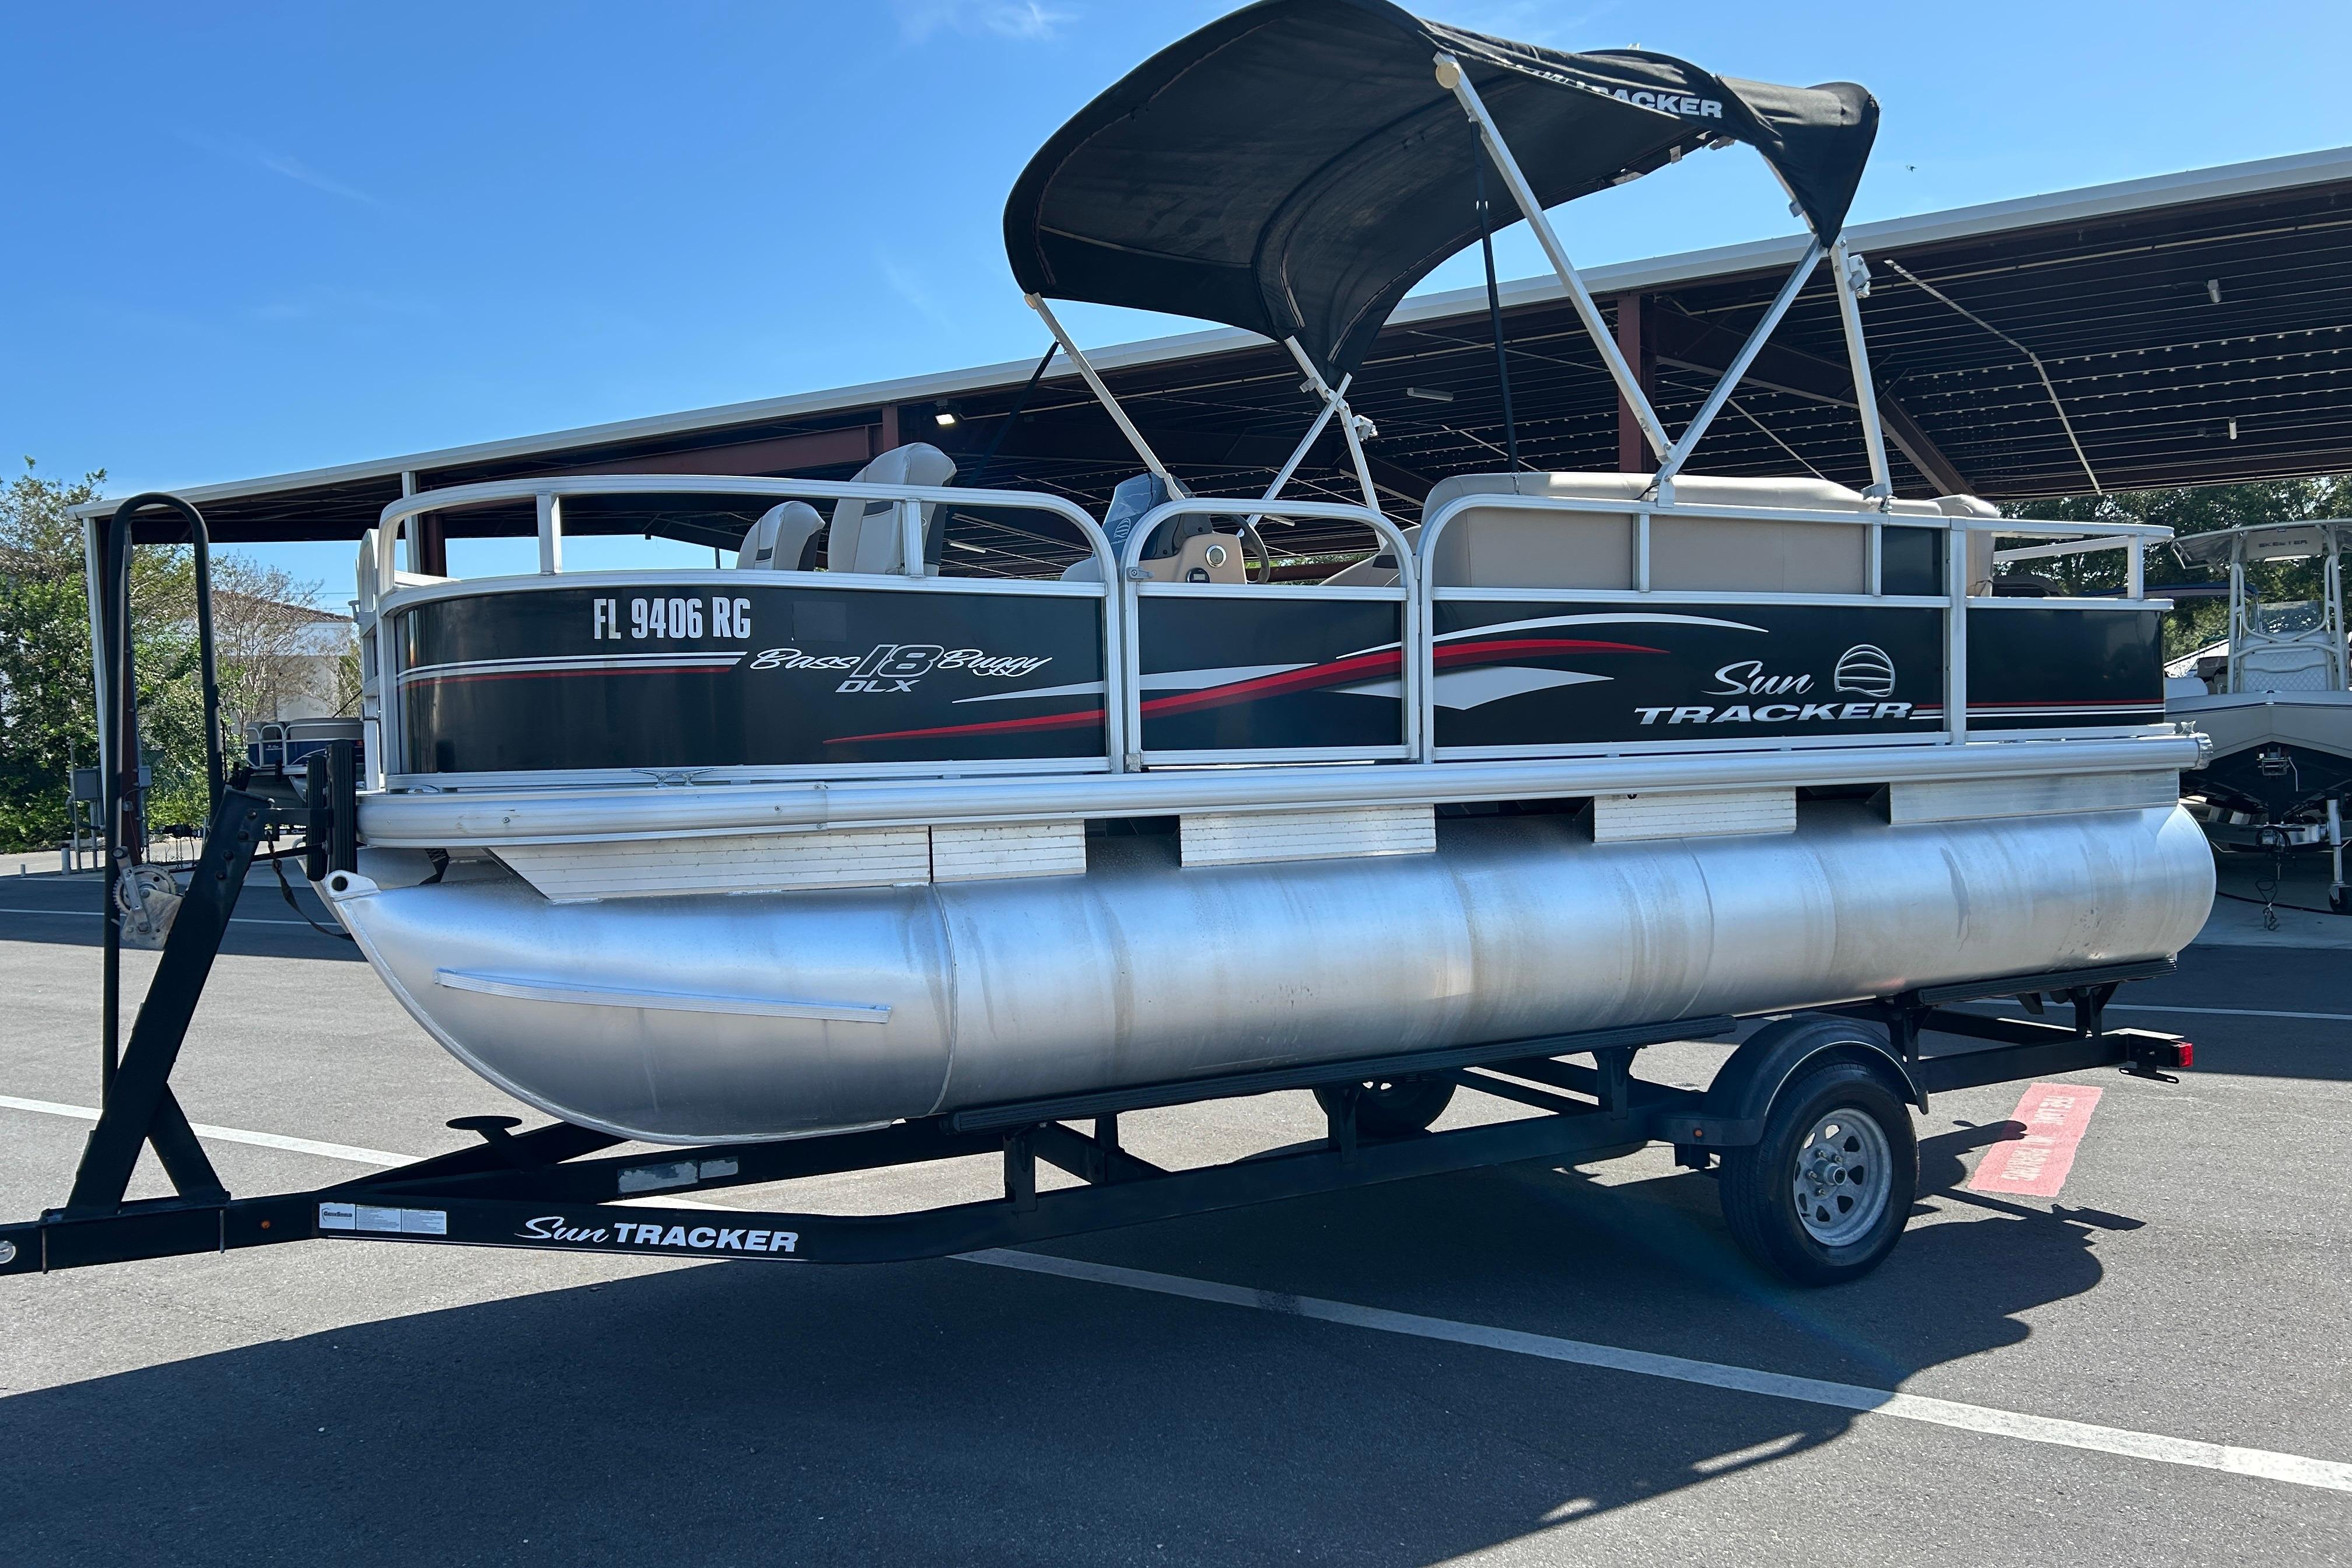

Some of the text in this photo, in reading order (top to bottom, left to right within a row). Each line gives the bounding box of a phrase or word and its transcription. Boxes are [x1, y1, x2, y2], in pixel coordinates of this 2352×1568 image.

[594, 597, 751, 639] FL 9406 RG
[750, 644, 1053, 678] Bass 18 Buggy
[1700, 660, 1815, 695] Sun
[835, 680, 920, 692] DLX
[1634, 702, 1913, 724] TRACKER
[514, 1216, 799, 1252] Sun TRACKER
